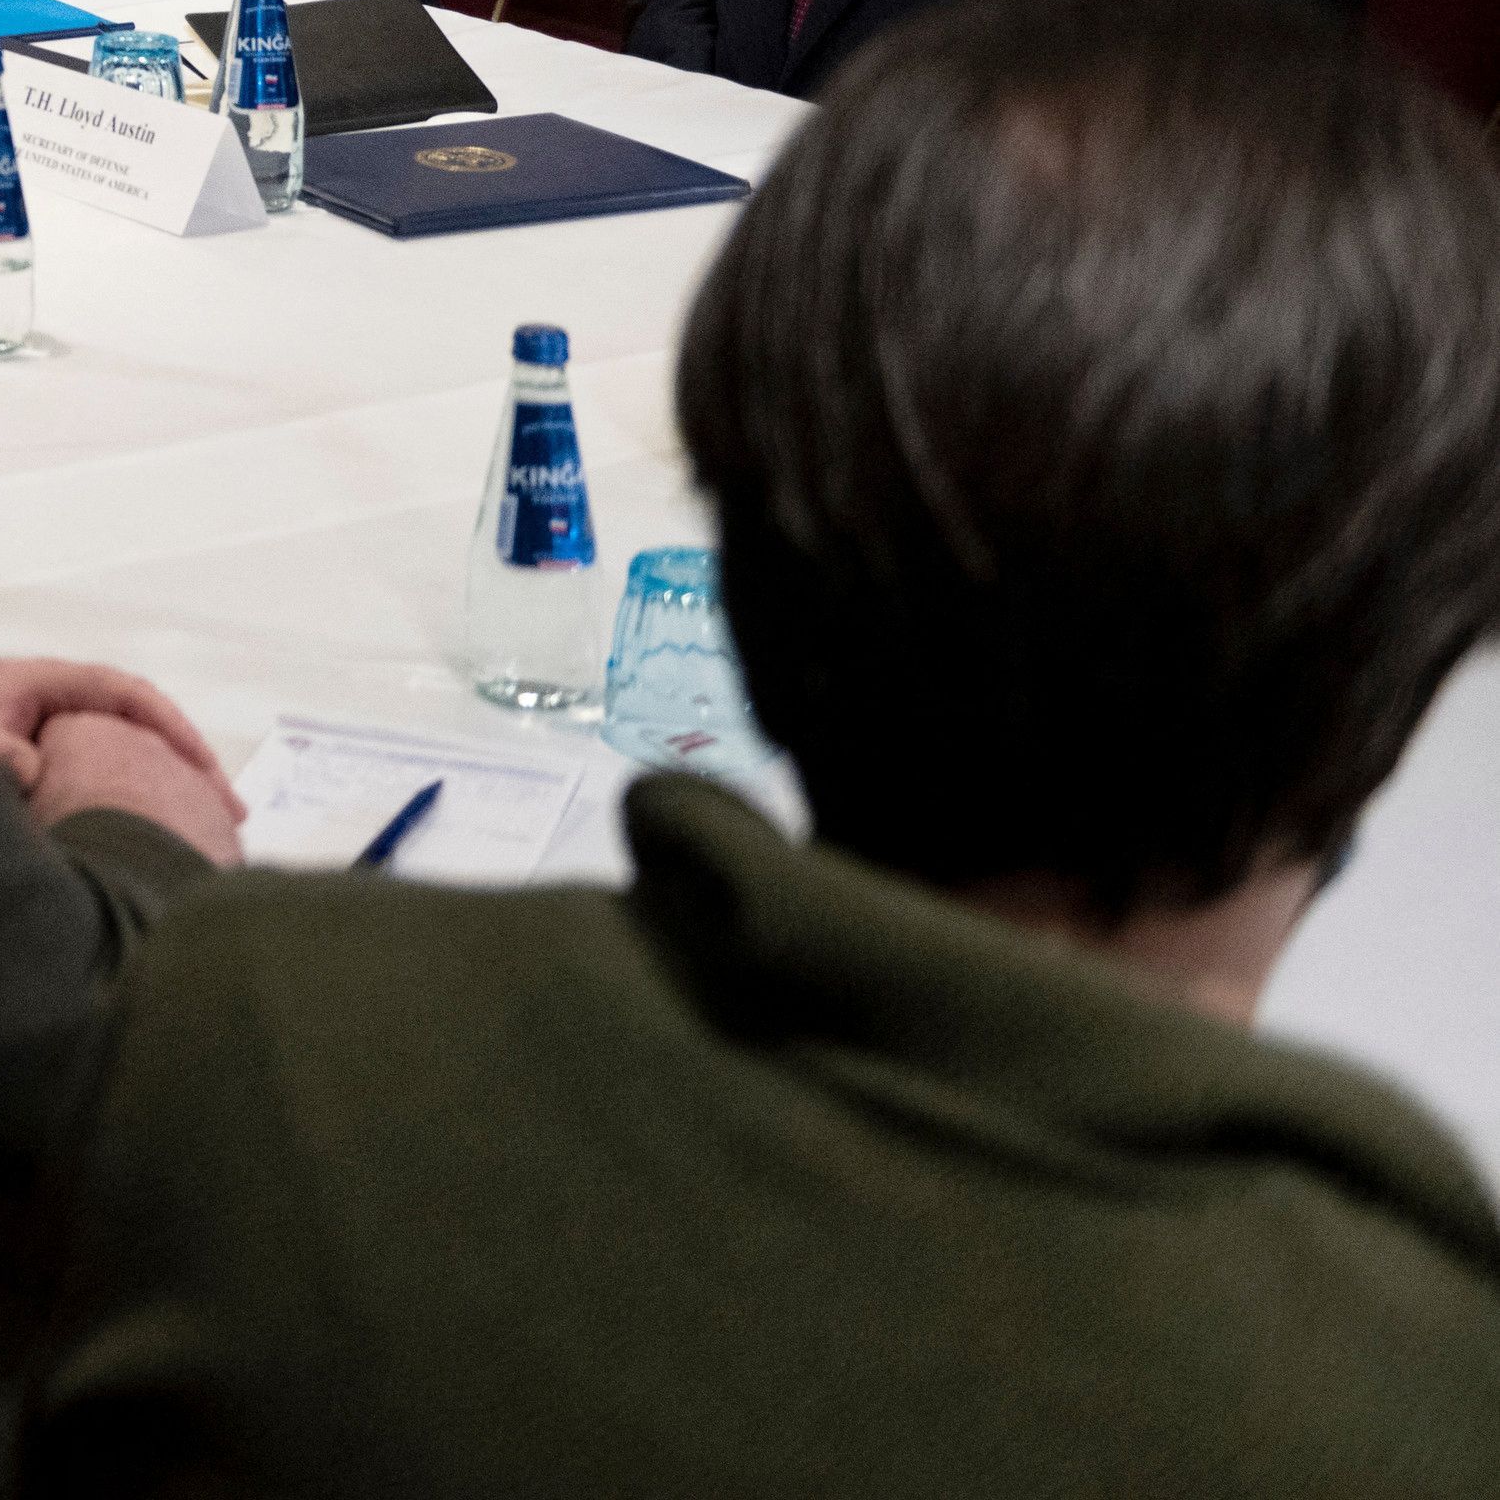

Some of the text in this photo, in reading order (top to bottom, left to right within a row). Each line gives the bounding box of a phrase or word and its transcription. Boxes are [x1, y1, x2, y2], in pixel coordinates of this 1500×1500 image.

[23, 85, 156, 146] T.H. Lloyd Austin
[22, 133, 74, 158] SECRETARY
[75, 151, 89, 162] OF
[59, 162, 92, 182] STATES
